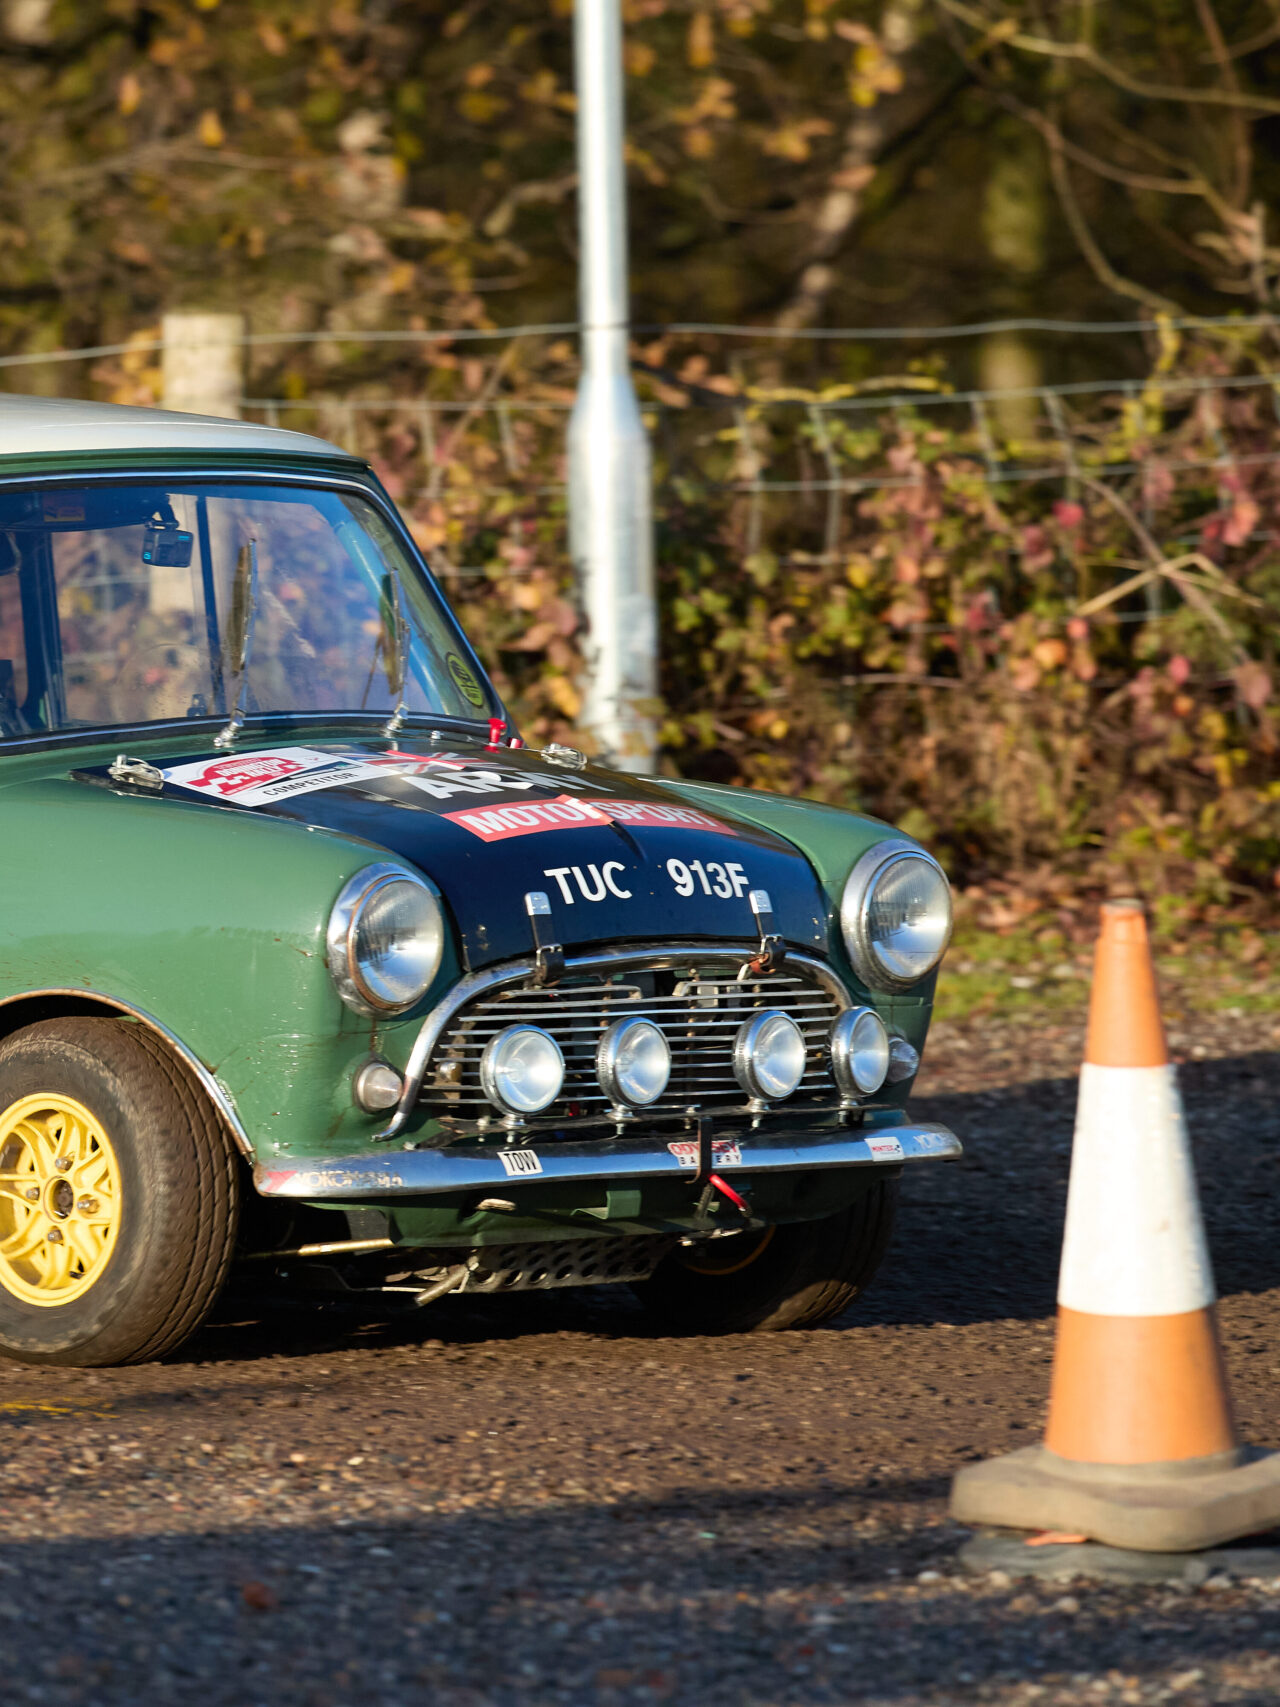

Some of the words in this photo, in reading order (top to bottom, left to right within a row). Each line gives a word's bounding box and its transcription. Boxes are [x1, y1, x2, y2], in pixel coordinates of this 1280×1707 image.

[263, 772, 358, 796] COMPETITOR
[400, 771, 615, 799] ARMY
[543, 861, 632, 905] TUC
[666, 858, 749, 899] 913F
[669, 1140, 737, 1155] ODYSEY
[680, 1154, 740, 1165] BAERY
